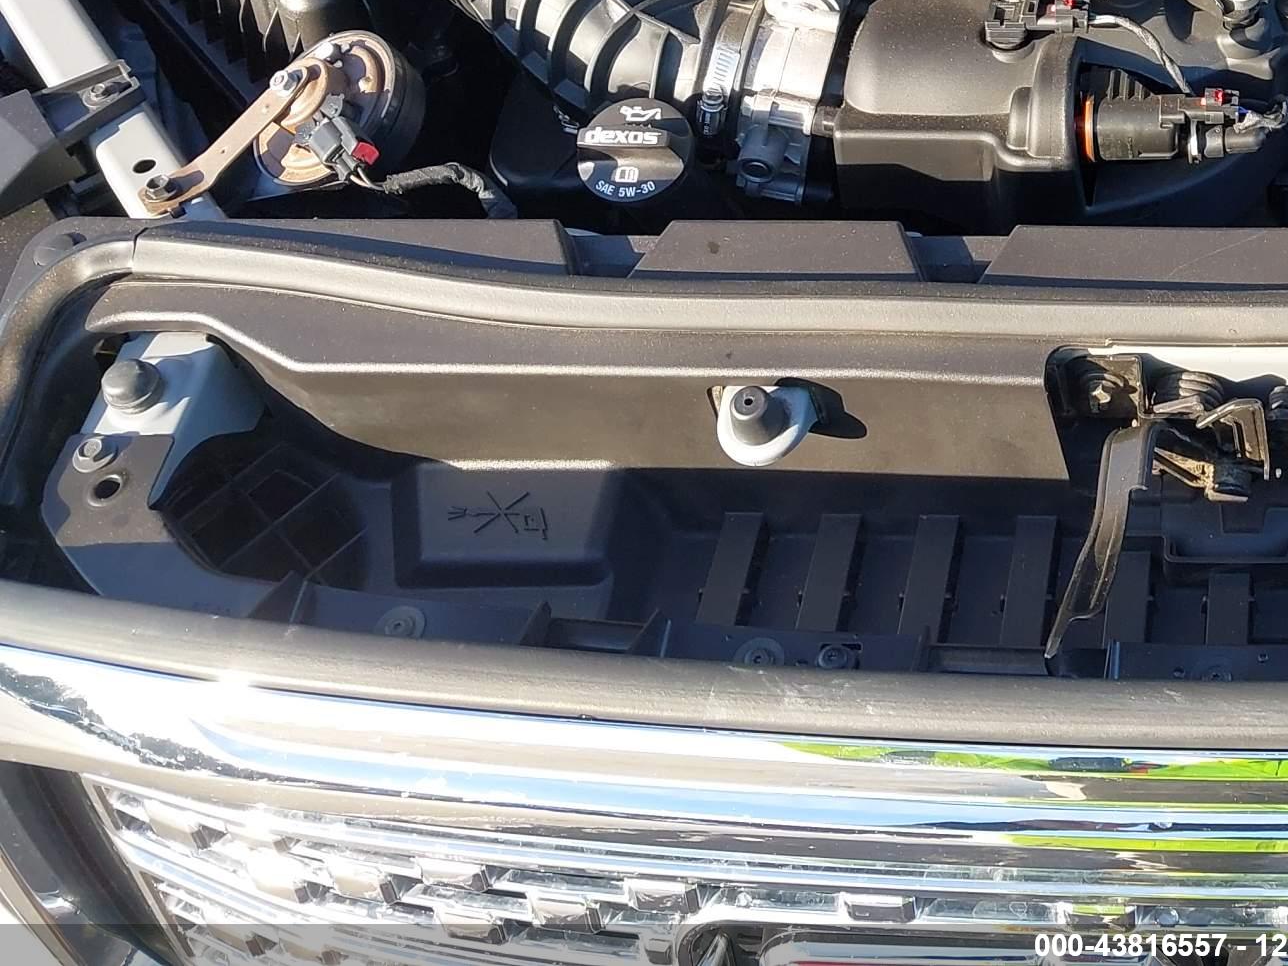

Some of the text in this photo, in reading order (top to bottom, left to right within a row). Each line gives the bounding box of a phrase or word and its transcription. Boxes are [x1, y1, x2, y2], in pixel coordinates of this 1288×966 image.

[584, 126, 662, 145] dexos
[595, 180, 656, 198] SAE 5W-30
